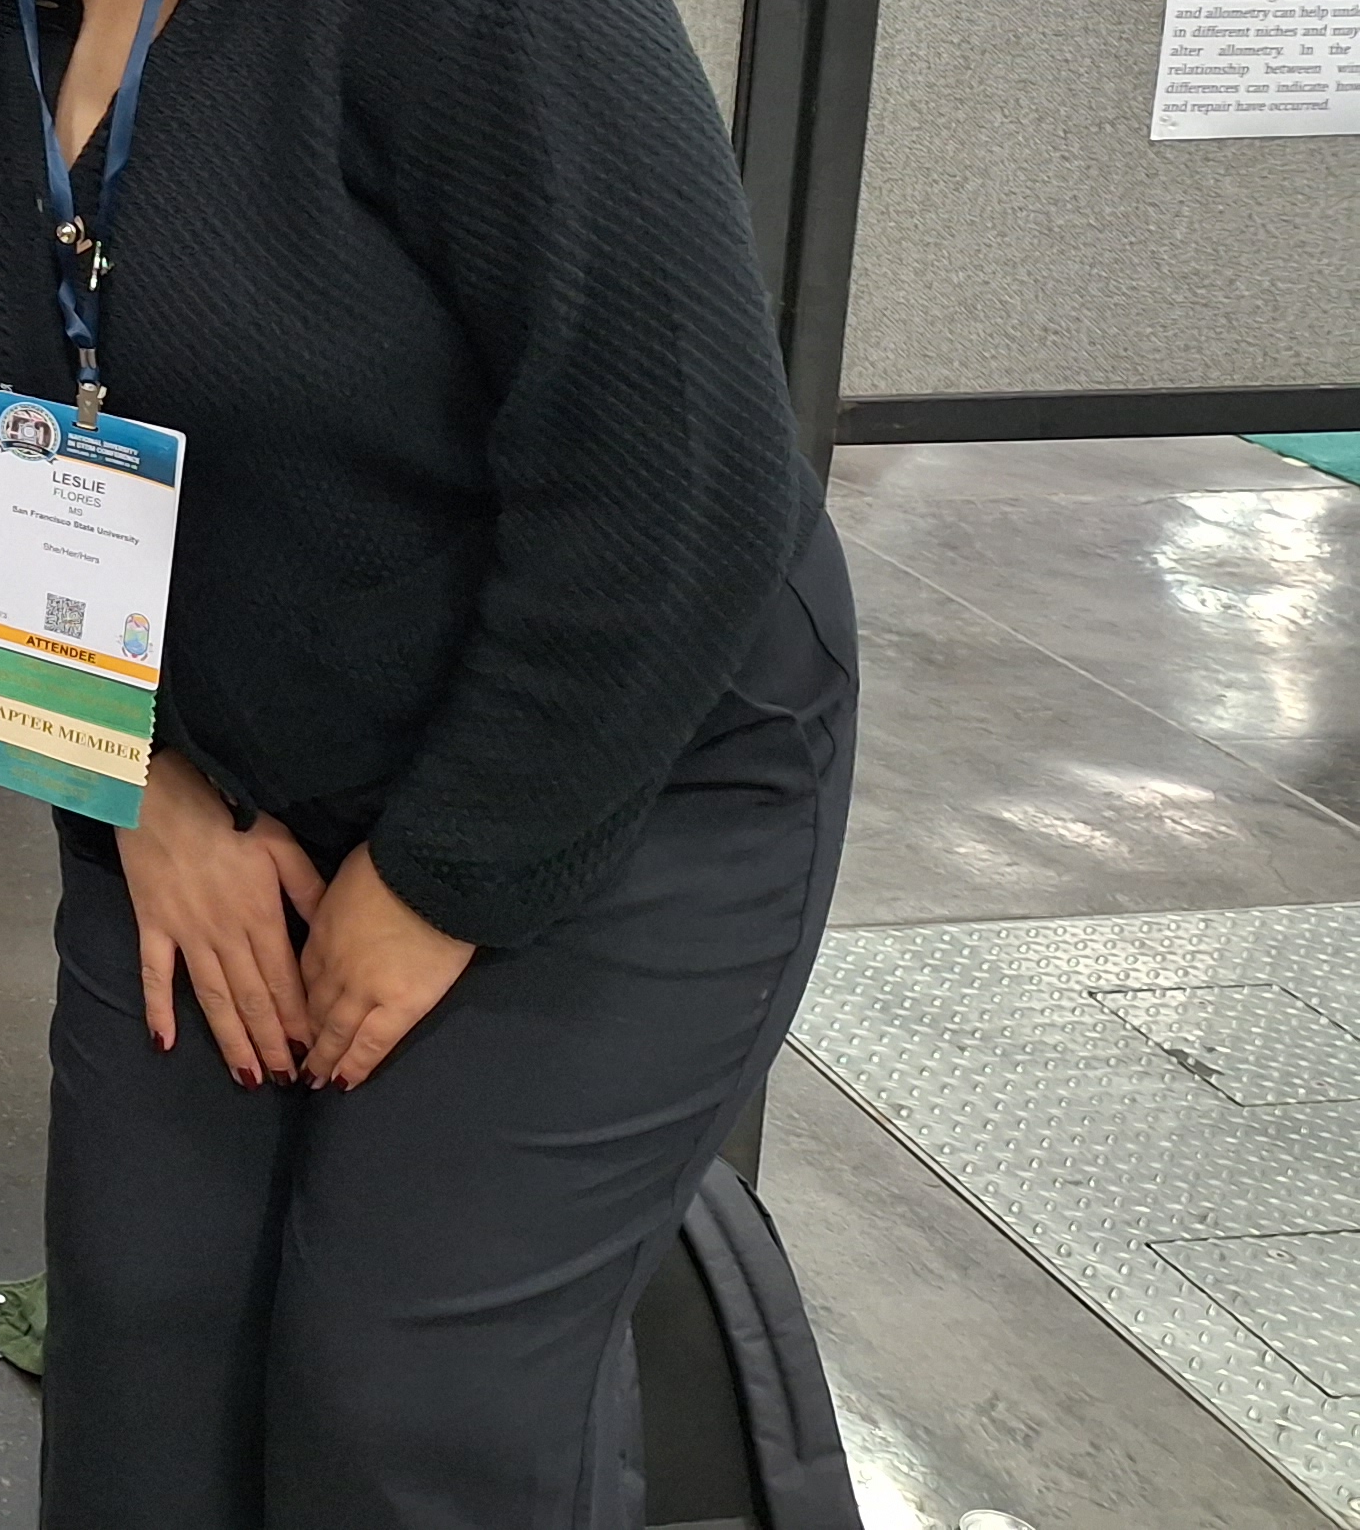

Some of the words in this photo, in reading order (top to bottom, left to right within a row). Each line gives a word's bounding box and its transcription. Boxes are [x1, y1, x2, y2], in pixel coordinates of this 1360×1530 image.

[52, 471, 106, 495] LESLIE
[53, 488, 102, 508] FLORES
[26, 635, 97, 664] ATTENDEE
[58, 725, 142, 763] MEMBER
